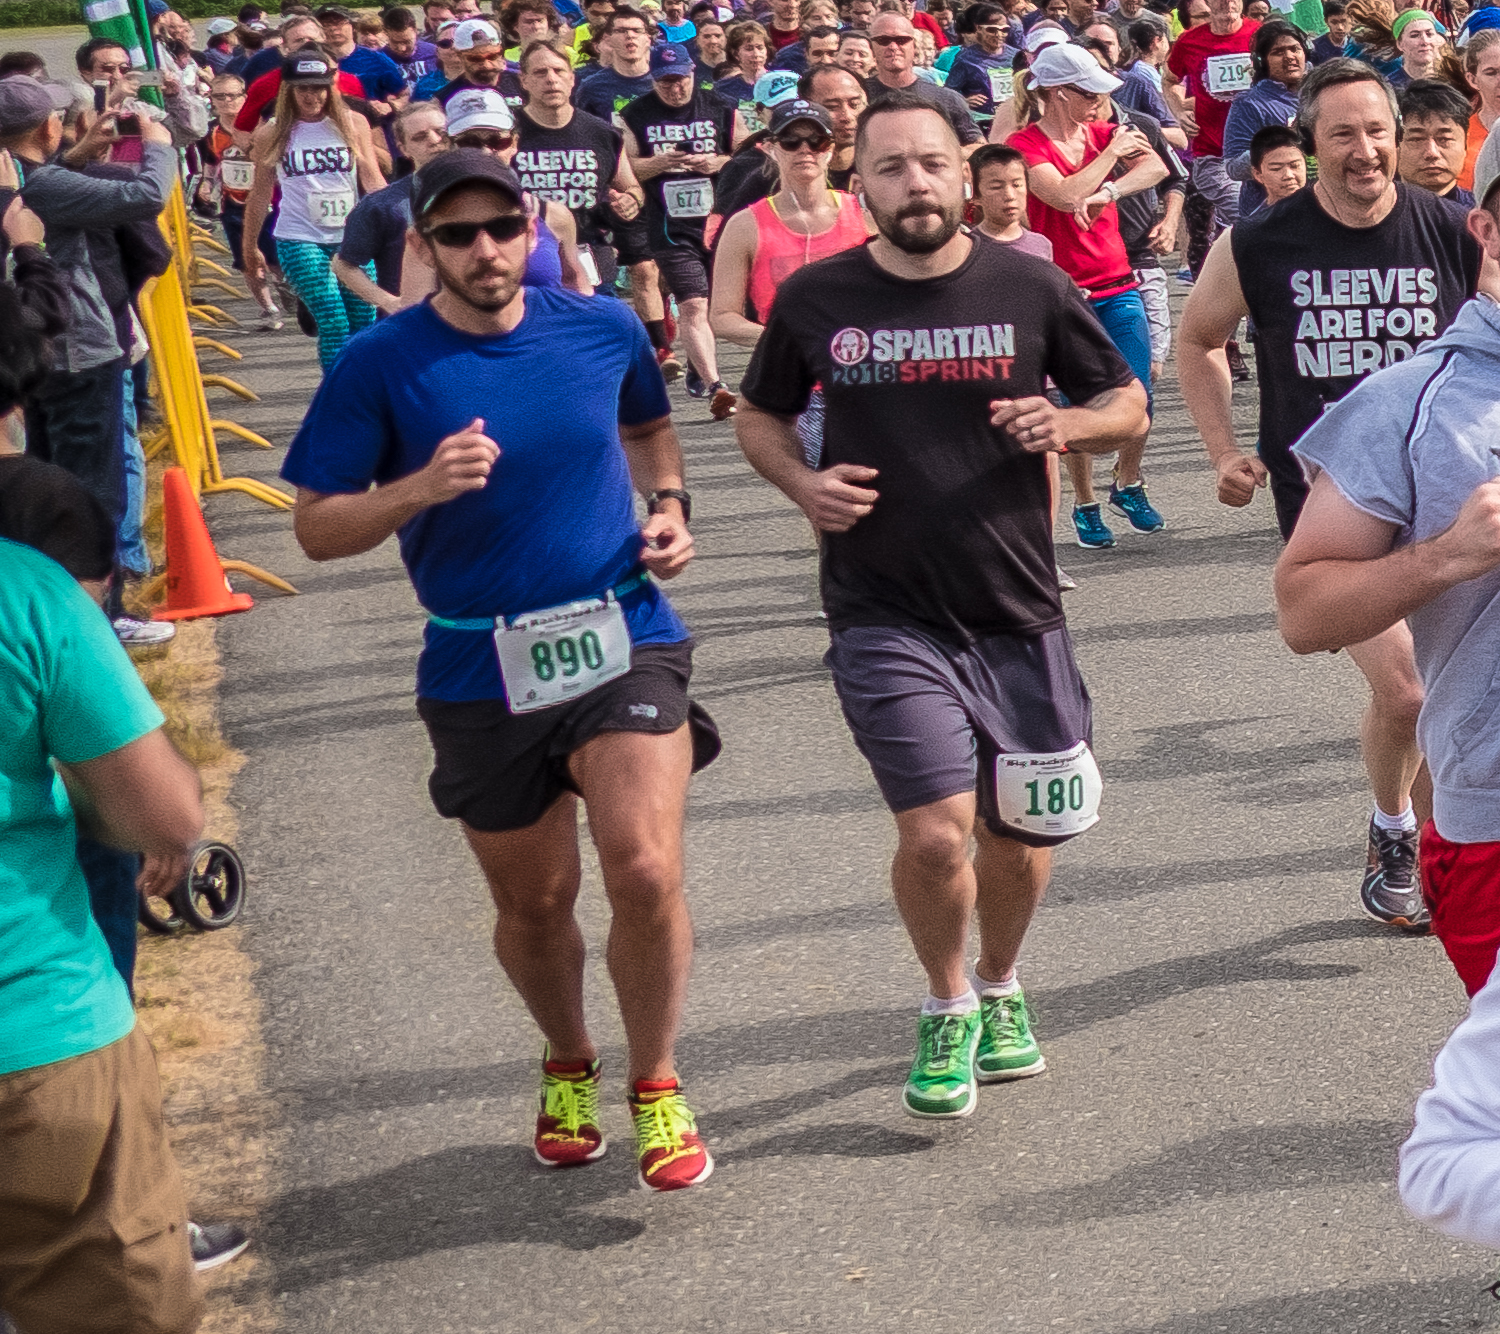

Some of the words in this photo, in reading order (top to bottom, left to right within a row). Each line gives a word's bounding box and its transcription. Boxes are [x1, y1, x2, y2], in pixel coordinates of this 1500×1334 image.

[1218, 64, 1245, 83] 219
[646, 120, 717, 143] SLEEVES
[515, 149, 599, 172] SLEEVES
[520, 173, 558, 189] ARE
[559, 172, 598, 188] FOR
[319, 200, 348, 217] 513
[1290, 267, 1438, 307] SLEEVES
[1296, 309, 1364, 340] ARE
[1367, 307, 1437, 338] FOR
[872, 323, 1016, 362] SPARTAN
[832, 363, 897, 385] 2018
[899, 357, 1015, 383] SPRINT
[530, 628, 605, 682] 890
[1006, 759, 1028, 768] Big
[1024, 773, 1084, 816] 180
